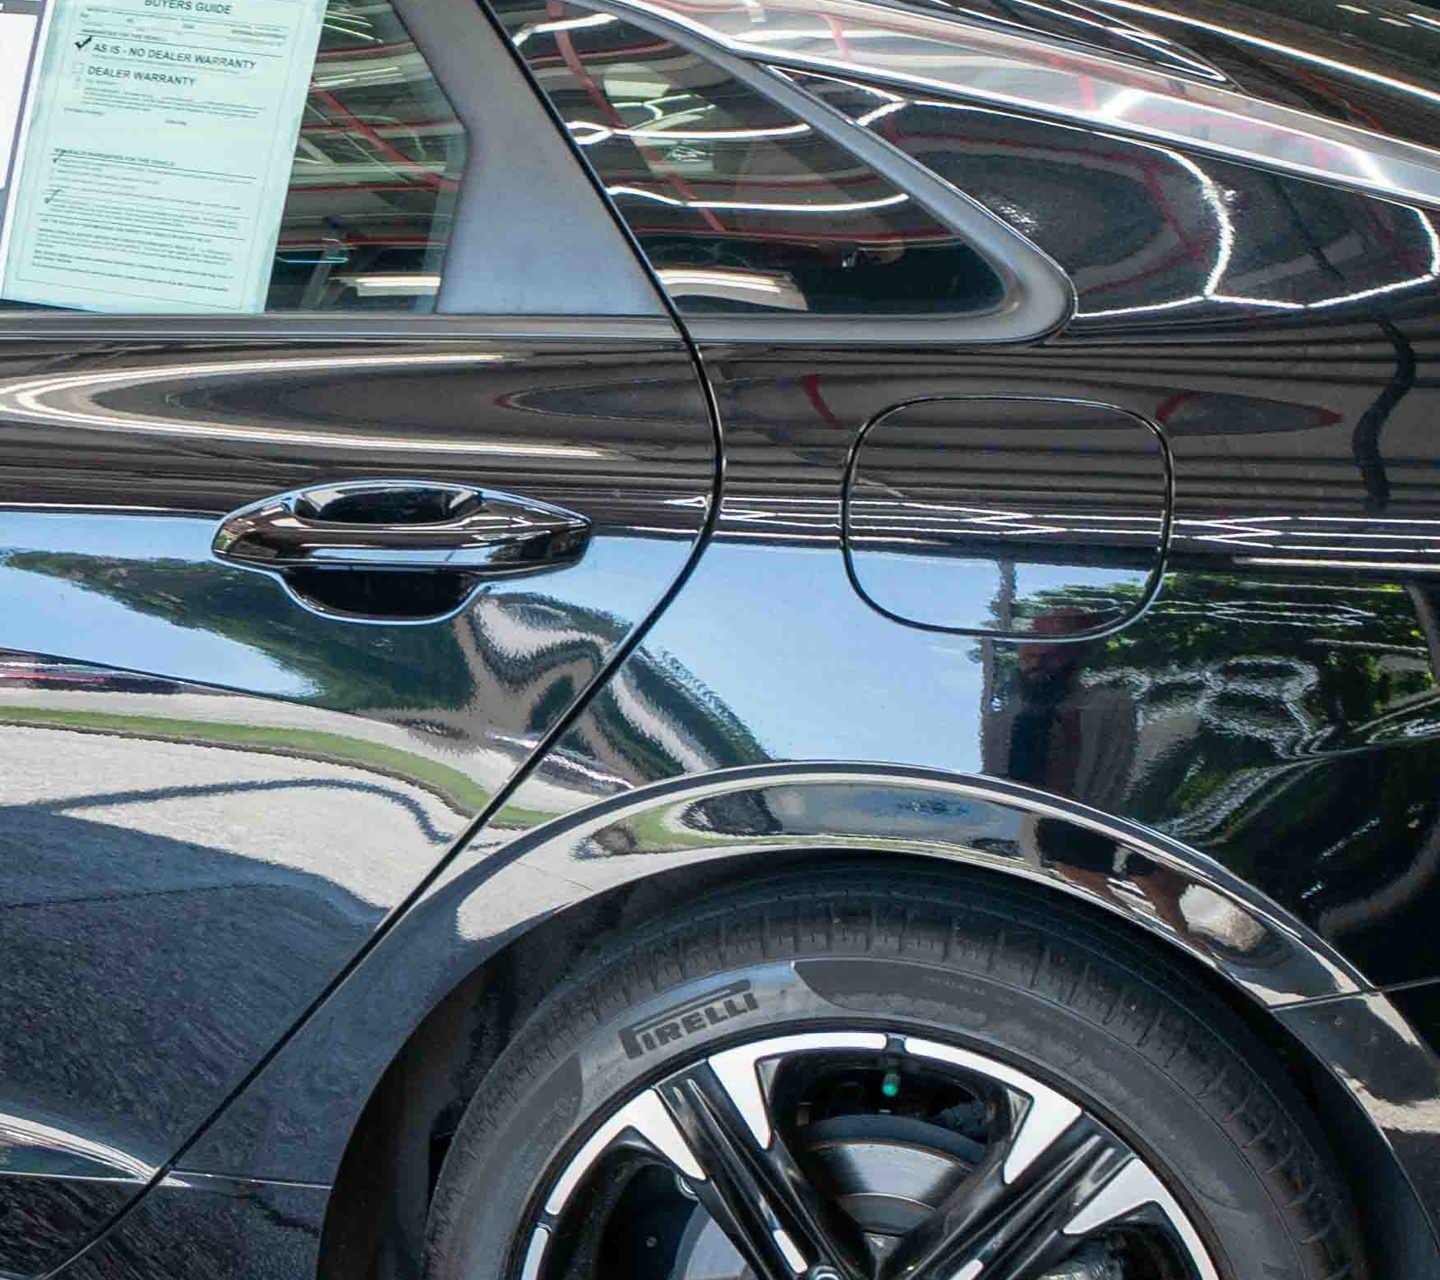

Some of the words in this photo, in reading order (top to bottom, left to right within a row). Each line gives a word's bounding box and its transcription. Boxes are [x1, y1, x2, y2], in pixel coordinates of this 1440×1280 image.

[195, 2, 233, 15] GUIDE
[93, 42, 108, 54] AS
[109, 44, 121, 55] IS
[130, 46, 145, 59] NO
[147, 49, 193, 64] DEALER
[194, 53, 258, 70] WARRANTY
[87, 64, 131, 79] DEALER
[132, 69, 198, 86] WARRANTY
[618, 978, 760, 1060] PIRELLI
